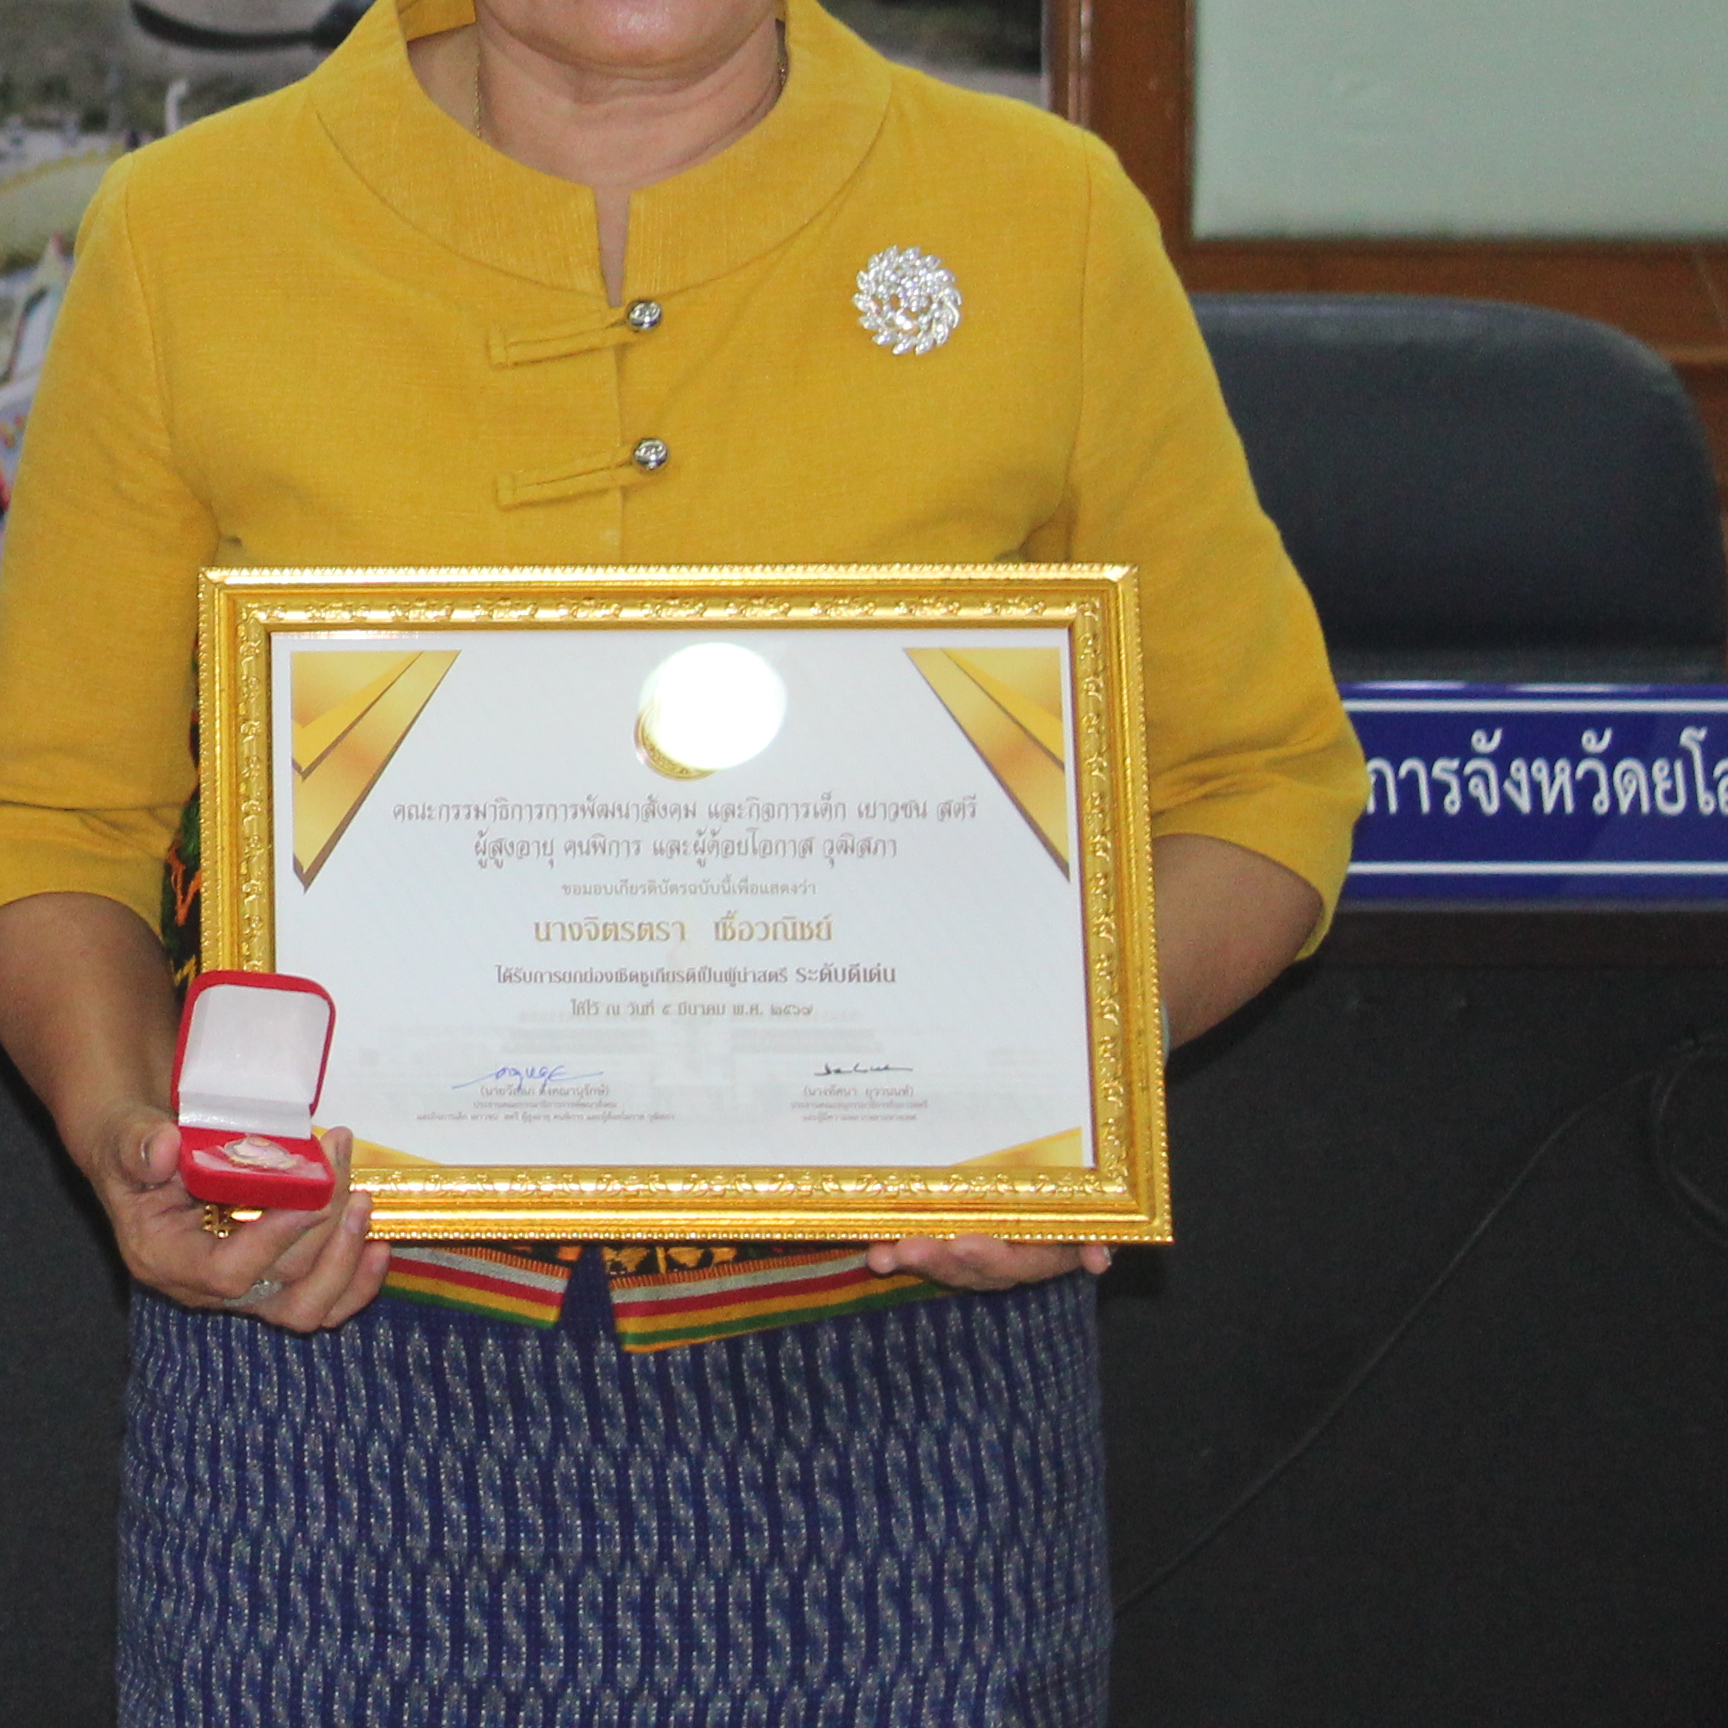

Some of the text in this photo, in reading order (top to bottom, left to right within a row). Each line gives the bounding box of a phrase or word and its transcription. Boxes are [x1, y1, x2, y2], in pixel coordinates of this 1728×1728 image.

[393, 790, 978, 823] คณะกรรมาธิการการพัฒนาสังคม และกิจการเด็ก เยาวชน สตรี
[474, 826, 897, 869] ผู้สูงอายุ คนพิการ และผู้ด้อยโอกาส วุฒิสภา
[533, 910, 834, 942] นางจิตรตรา เชื้อวณิชย์
[795, 962, 896, 983] ระดับดีเด่น
